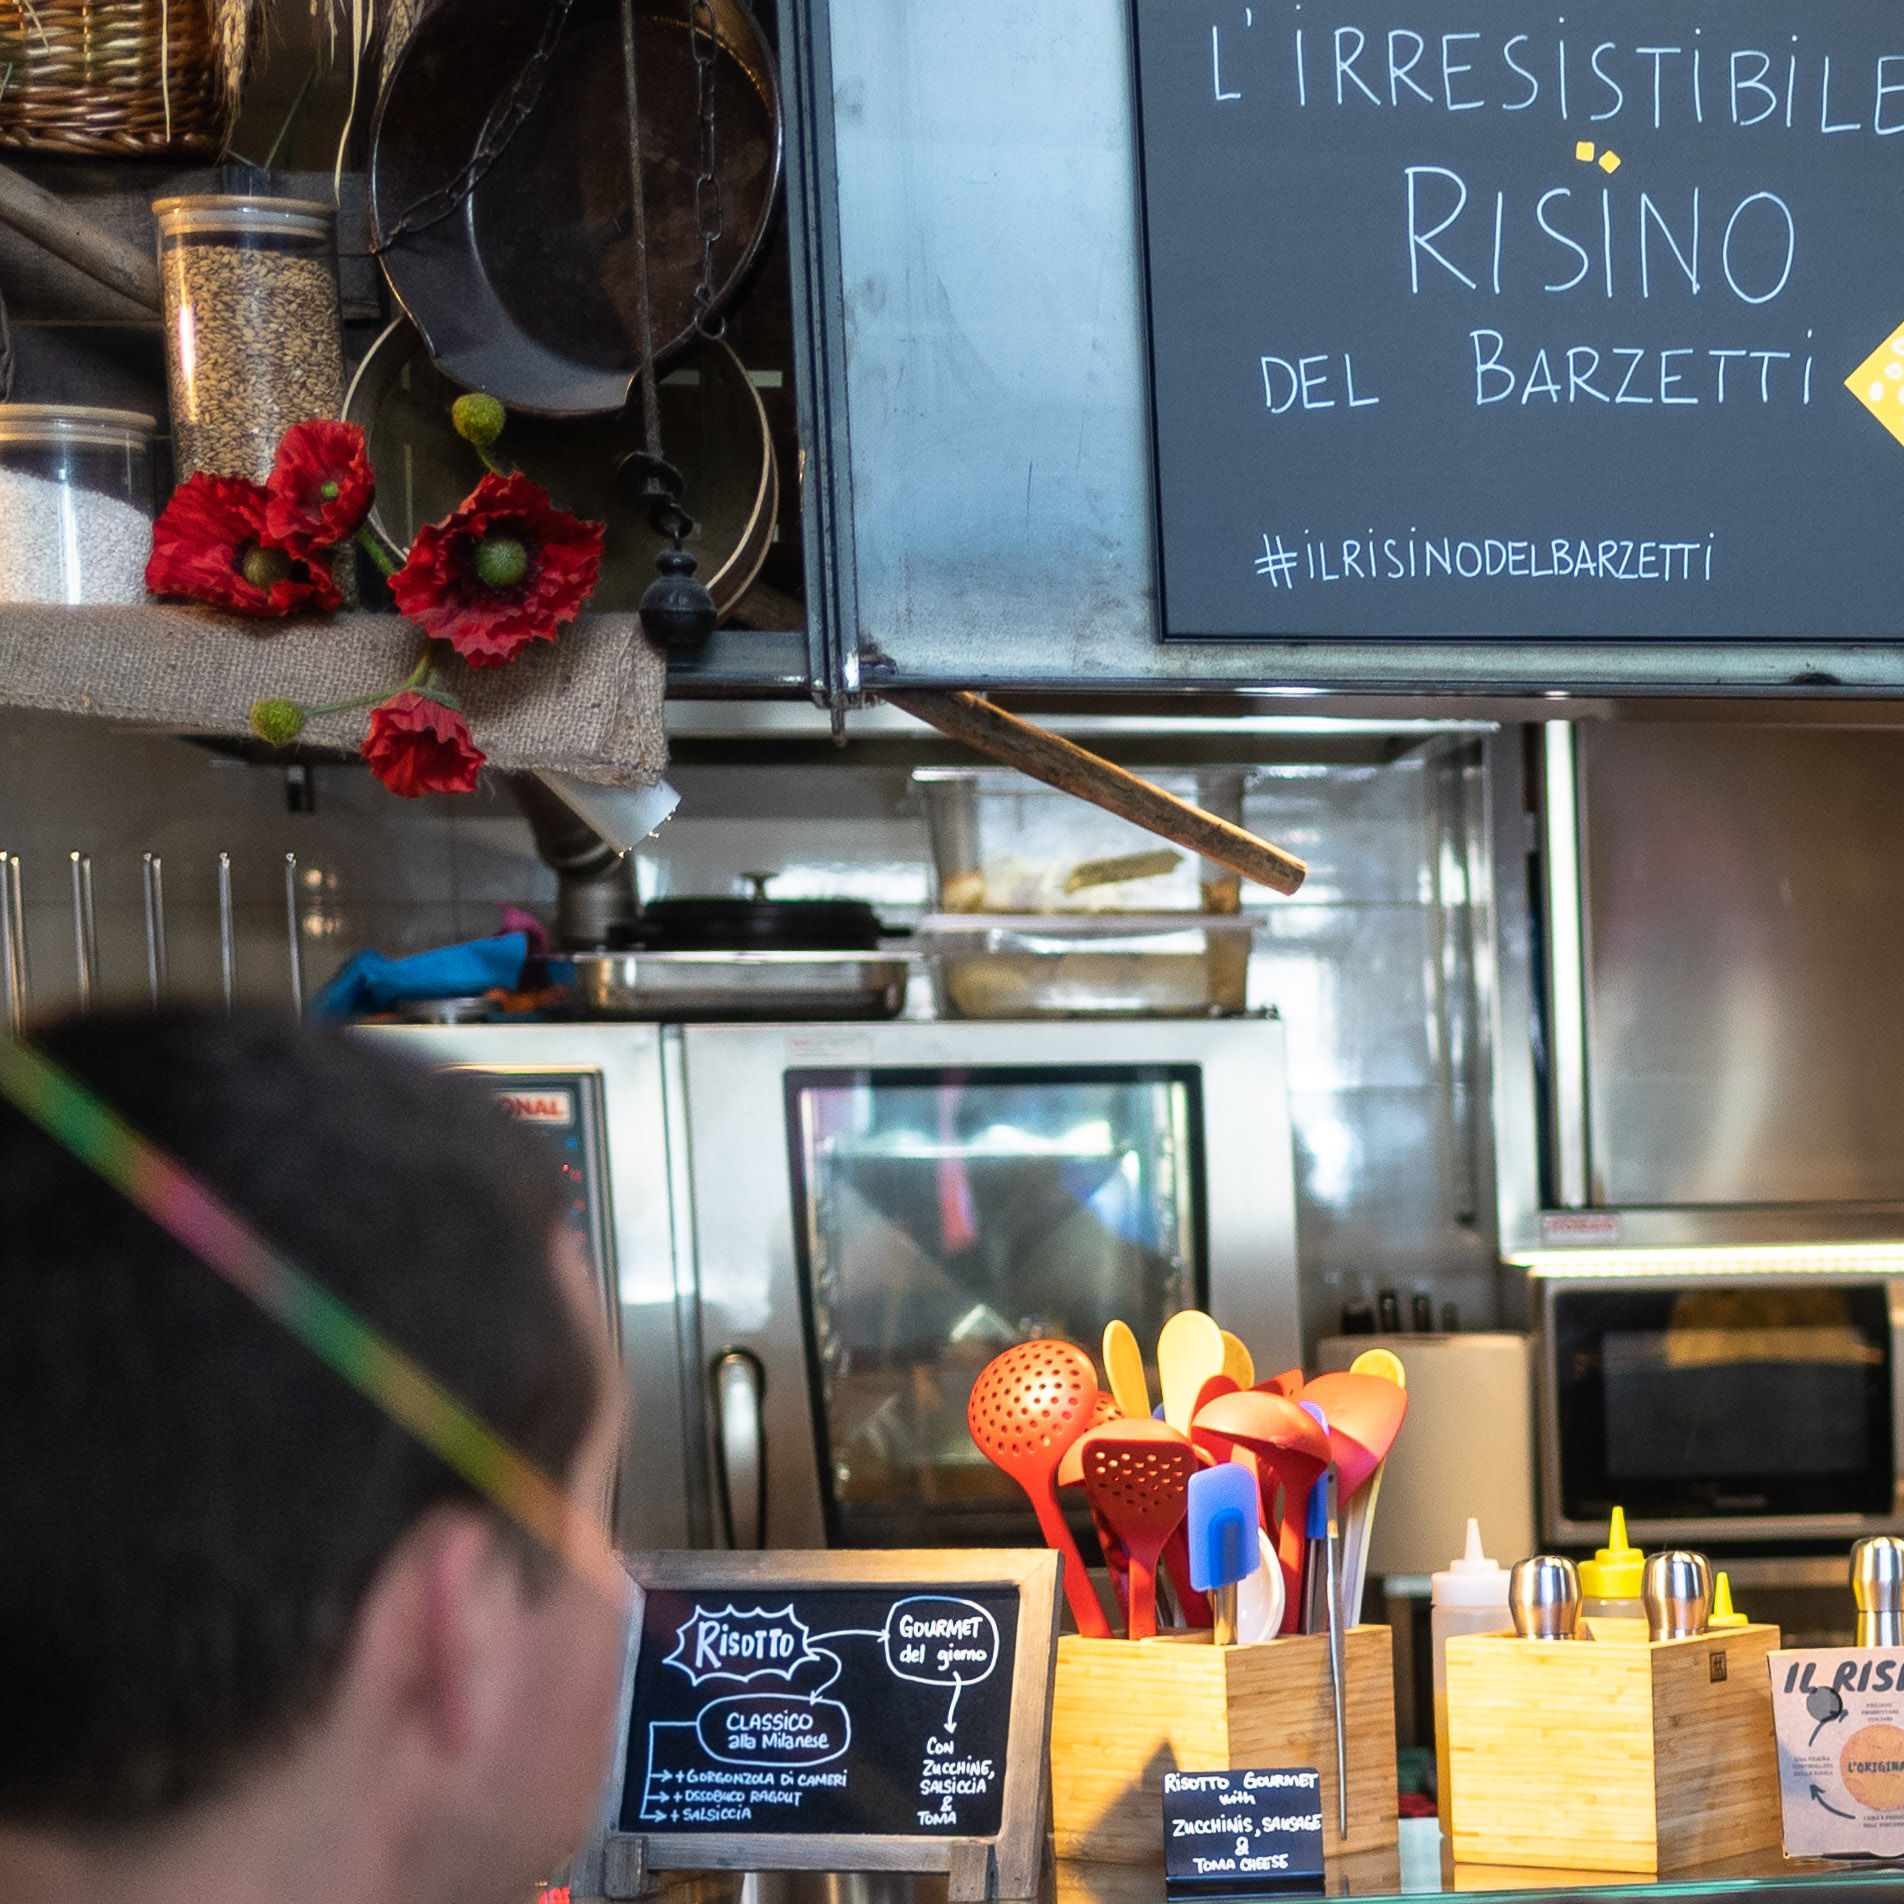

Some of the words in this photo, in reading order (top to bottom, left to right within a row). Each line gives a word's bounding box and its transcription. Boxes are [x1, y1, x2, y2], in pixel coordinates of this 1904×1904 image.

[1403, 165, 1796, 304] RISINO
[1259, 352, 1381, 415] DEL
[1469, 328, 1815, 406] BARZETTI
[900, 1615, 983, 1638] GOURMET
[900, 1645, 925, 1663] del
[1784, 1662, 1817, 1694] IL
[726, 1712, 814, 1731] CLASSICO
[728, 1732, 757, 1749] alla
[761, 1732, 829, 1750] Milanese
[922, 1759, 995, 1779] ZUCCHINE,
[687, 1770, 775, 1787] GORGONZOLA
[797, 1771, 848, 1787] CAMERI
[920, 1778, 987, 1796] SALSICCIA
[1243, 1771, 1319, 1789] GOURMET
[682, 1807, 752, 1822] SALSICCIA
[917, 1811, 957, 1826] TOMA
[1193, 1857, 1236, 1874] TOMA
[1239, 1853, 1289, 1872] CHEESE
